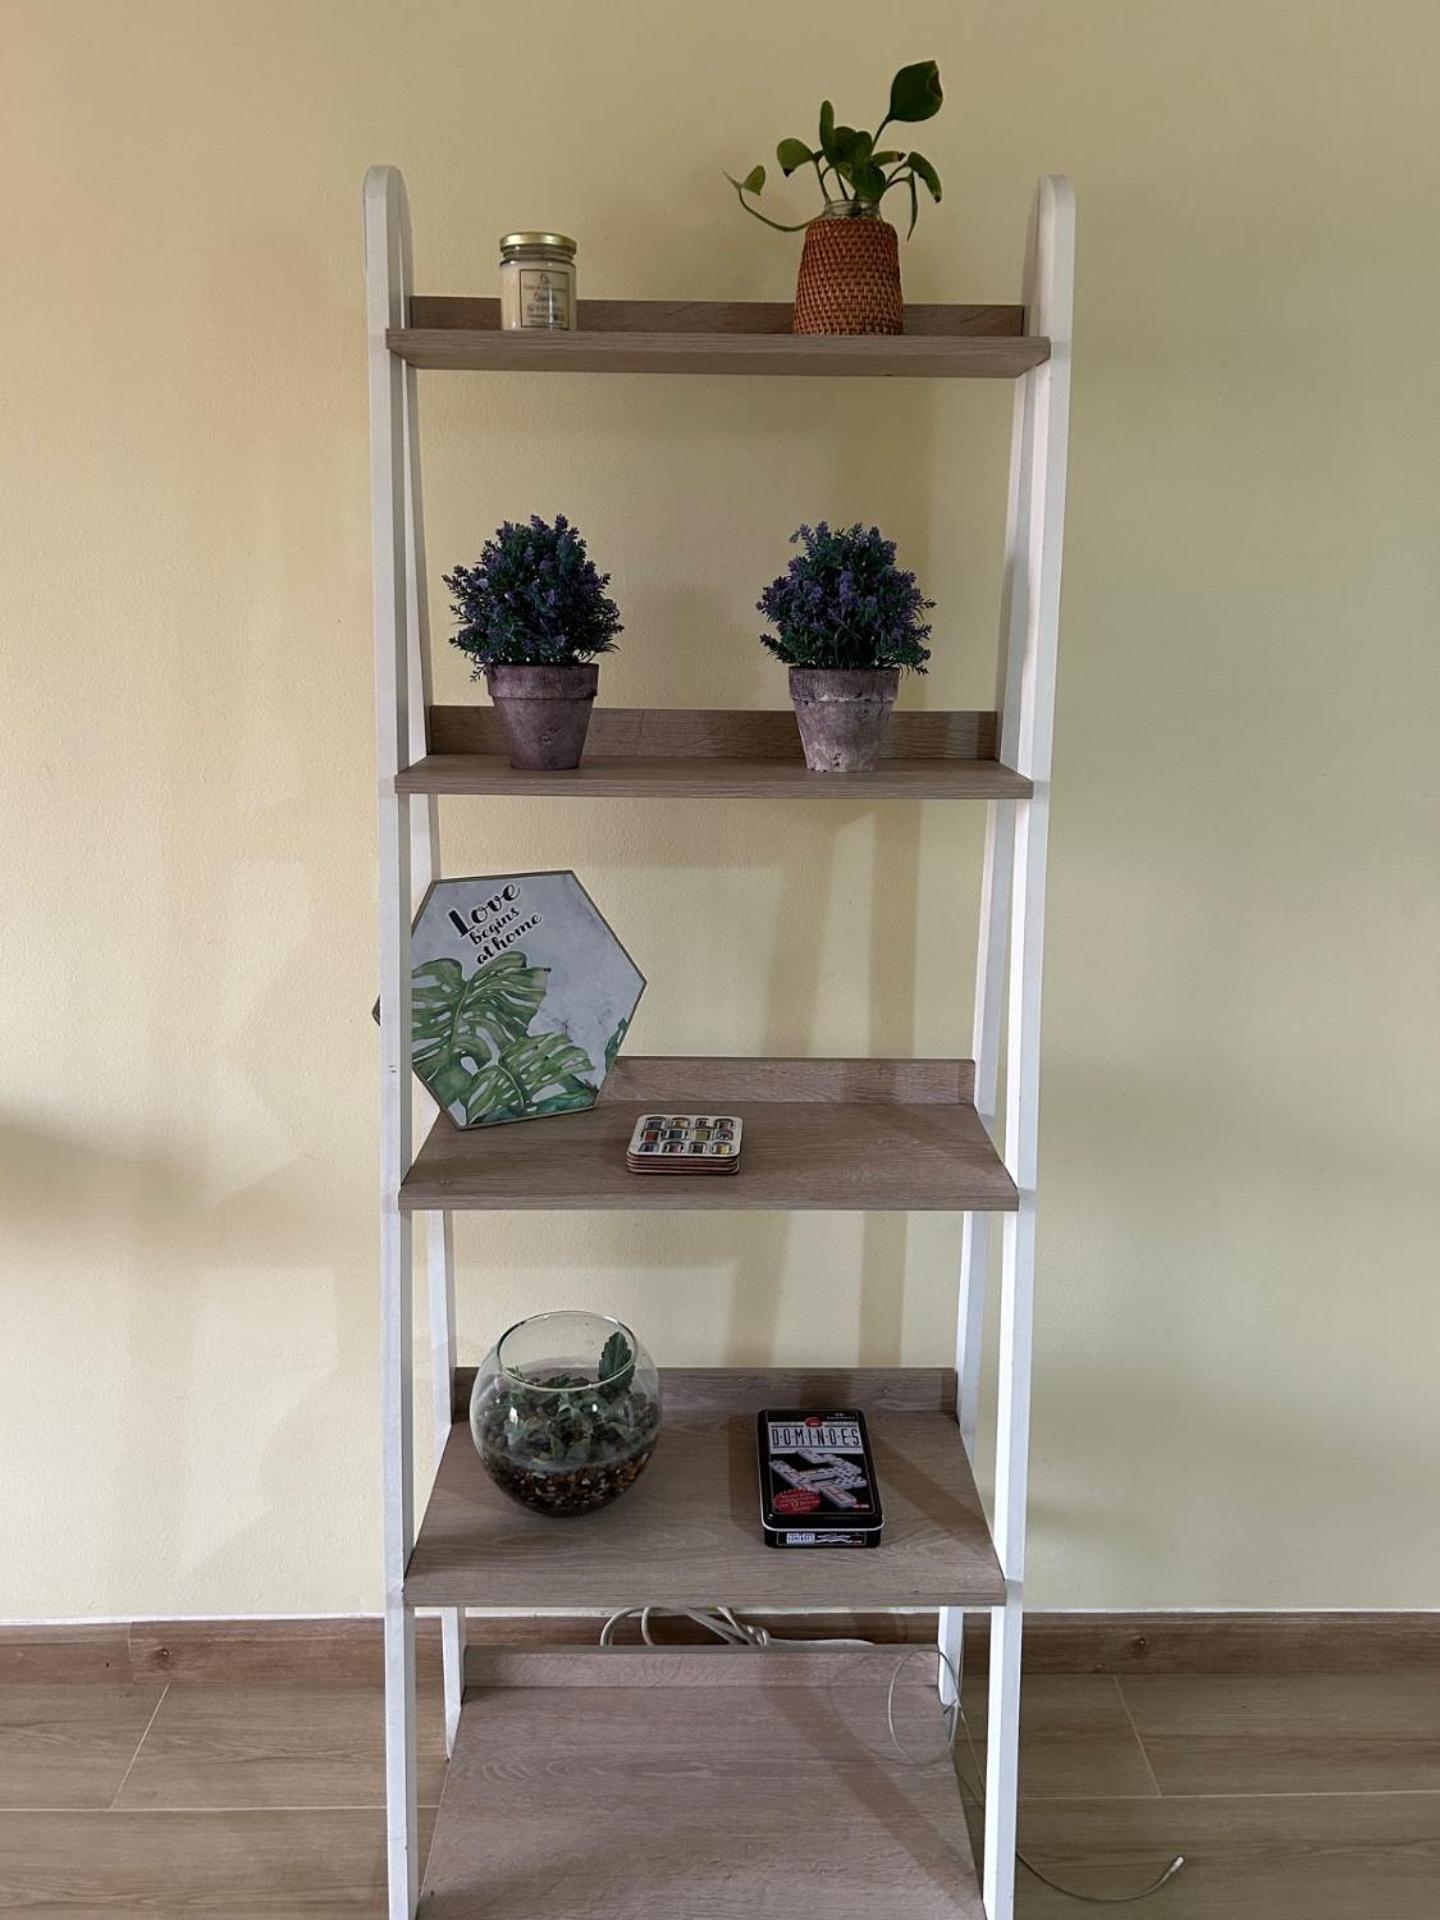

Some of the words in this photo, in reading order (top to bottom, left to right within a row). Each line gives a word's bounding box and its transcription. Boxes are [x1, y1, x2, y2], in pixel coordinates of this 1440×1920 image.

[448, 884, 521, 937] Love
[469, 907, 520, 945] begins
[476, 945, 494, 964] at
[491, 914, 542, 950] home
